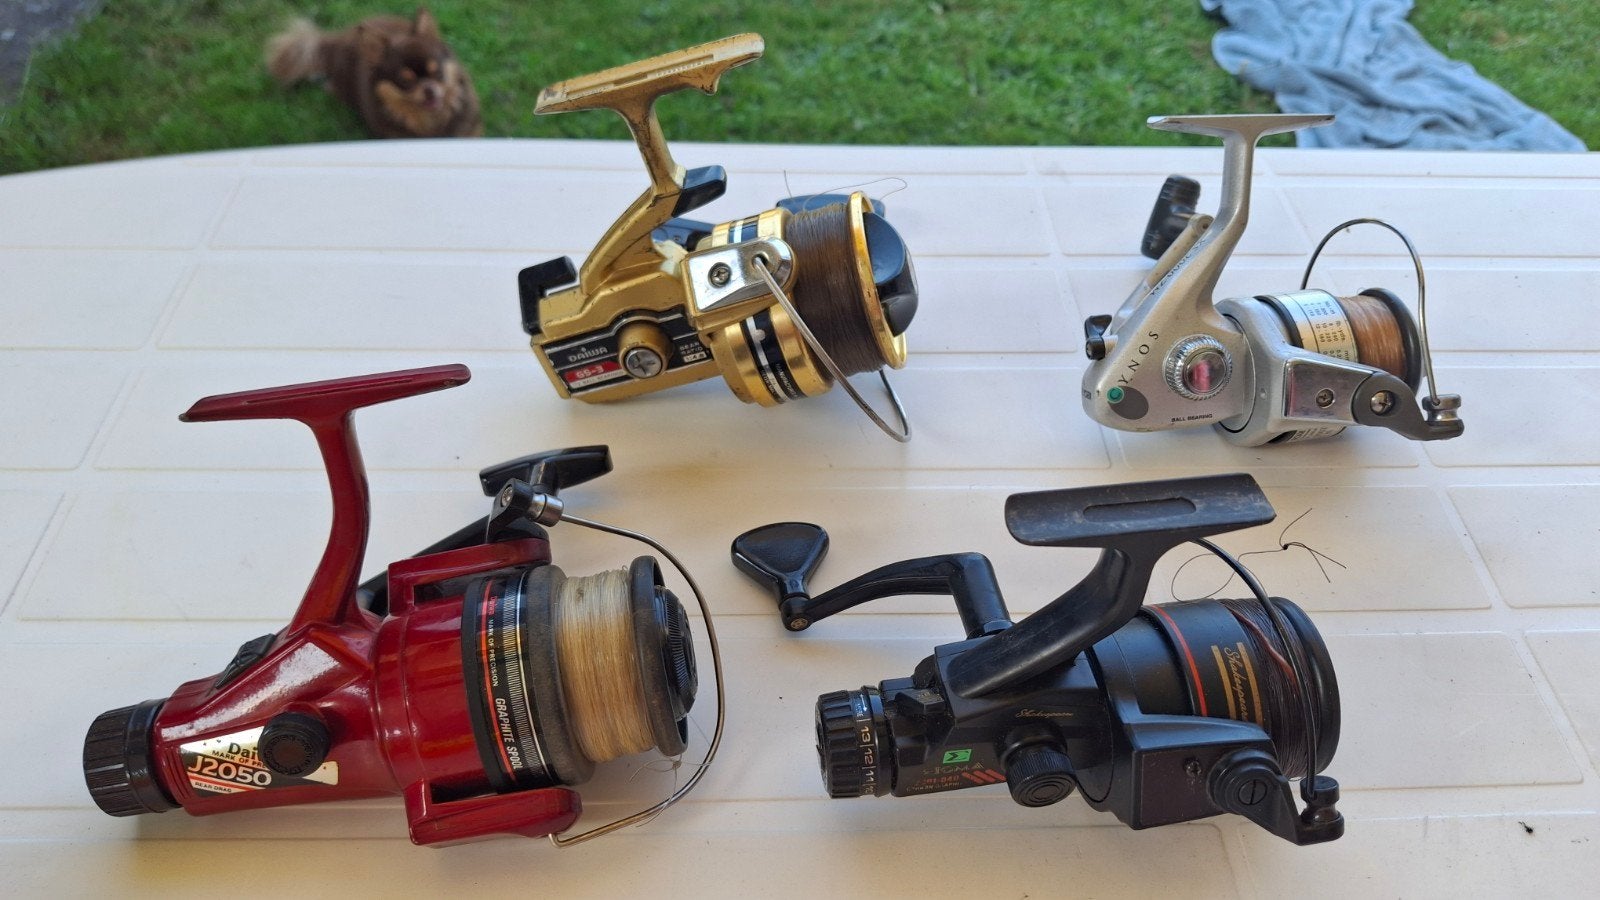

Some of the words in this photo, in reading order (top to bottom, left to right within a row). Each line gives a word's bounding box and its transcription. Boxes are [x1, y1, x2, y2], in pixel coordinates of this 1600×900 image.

[568, 346, 609, 363] DAIWA
[487, 619, 495, 637] MARK
[488, 638, 495, 648] OF
[488, 649, 499, 687] PRECISION
[495, 698, 514, 743] GRAPHITE
[506, 745, 523, 770] SPOOL
[860, 725, 871, 743] 13
[211, 750, 236, 761] MARK
[864, 748, 874, 765] 12
[187, 755, 272, 786] J2050
[194, 781, 212, 790] REAR
[213, 785, 232, 793] DRAG
